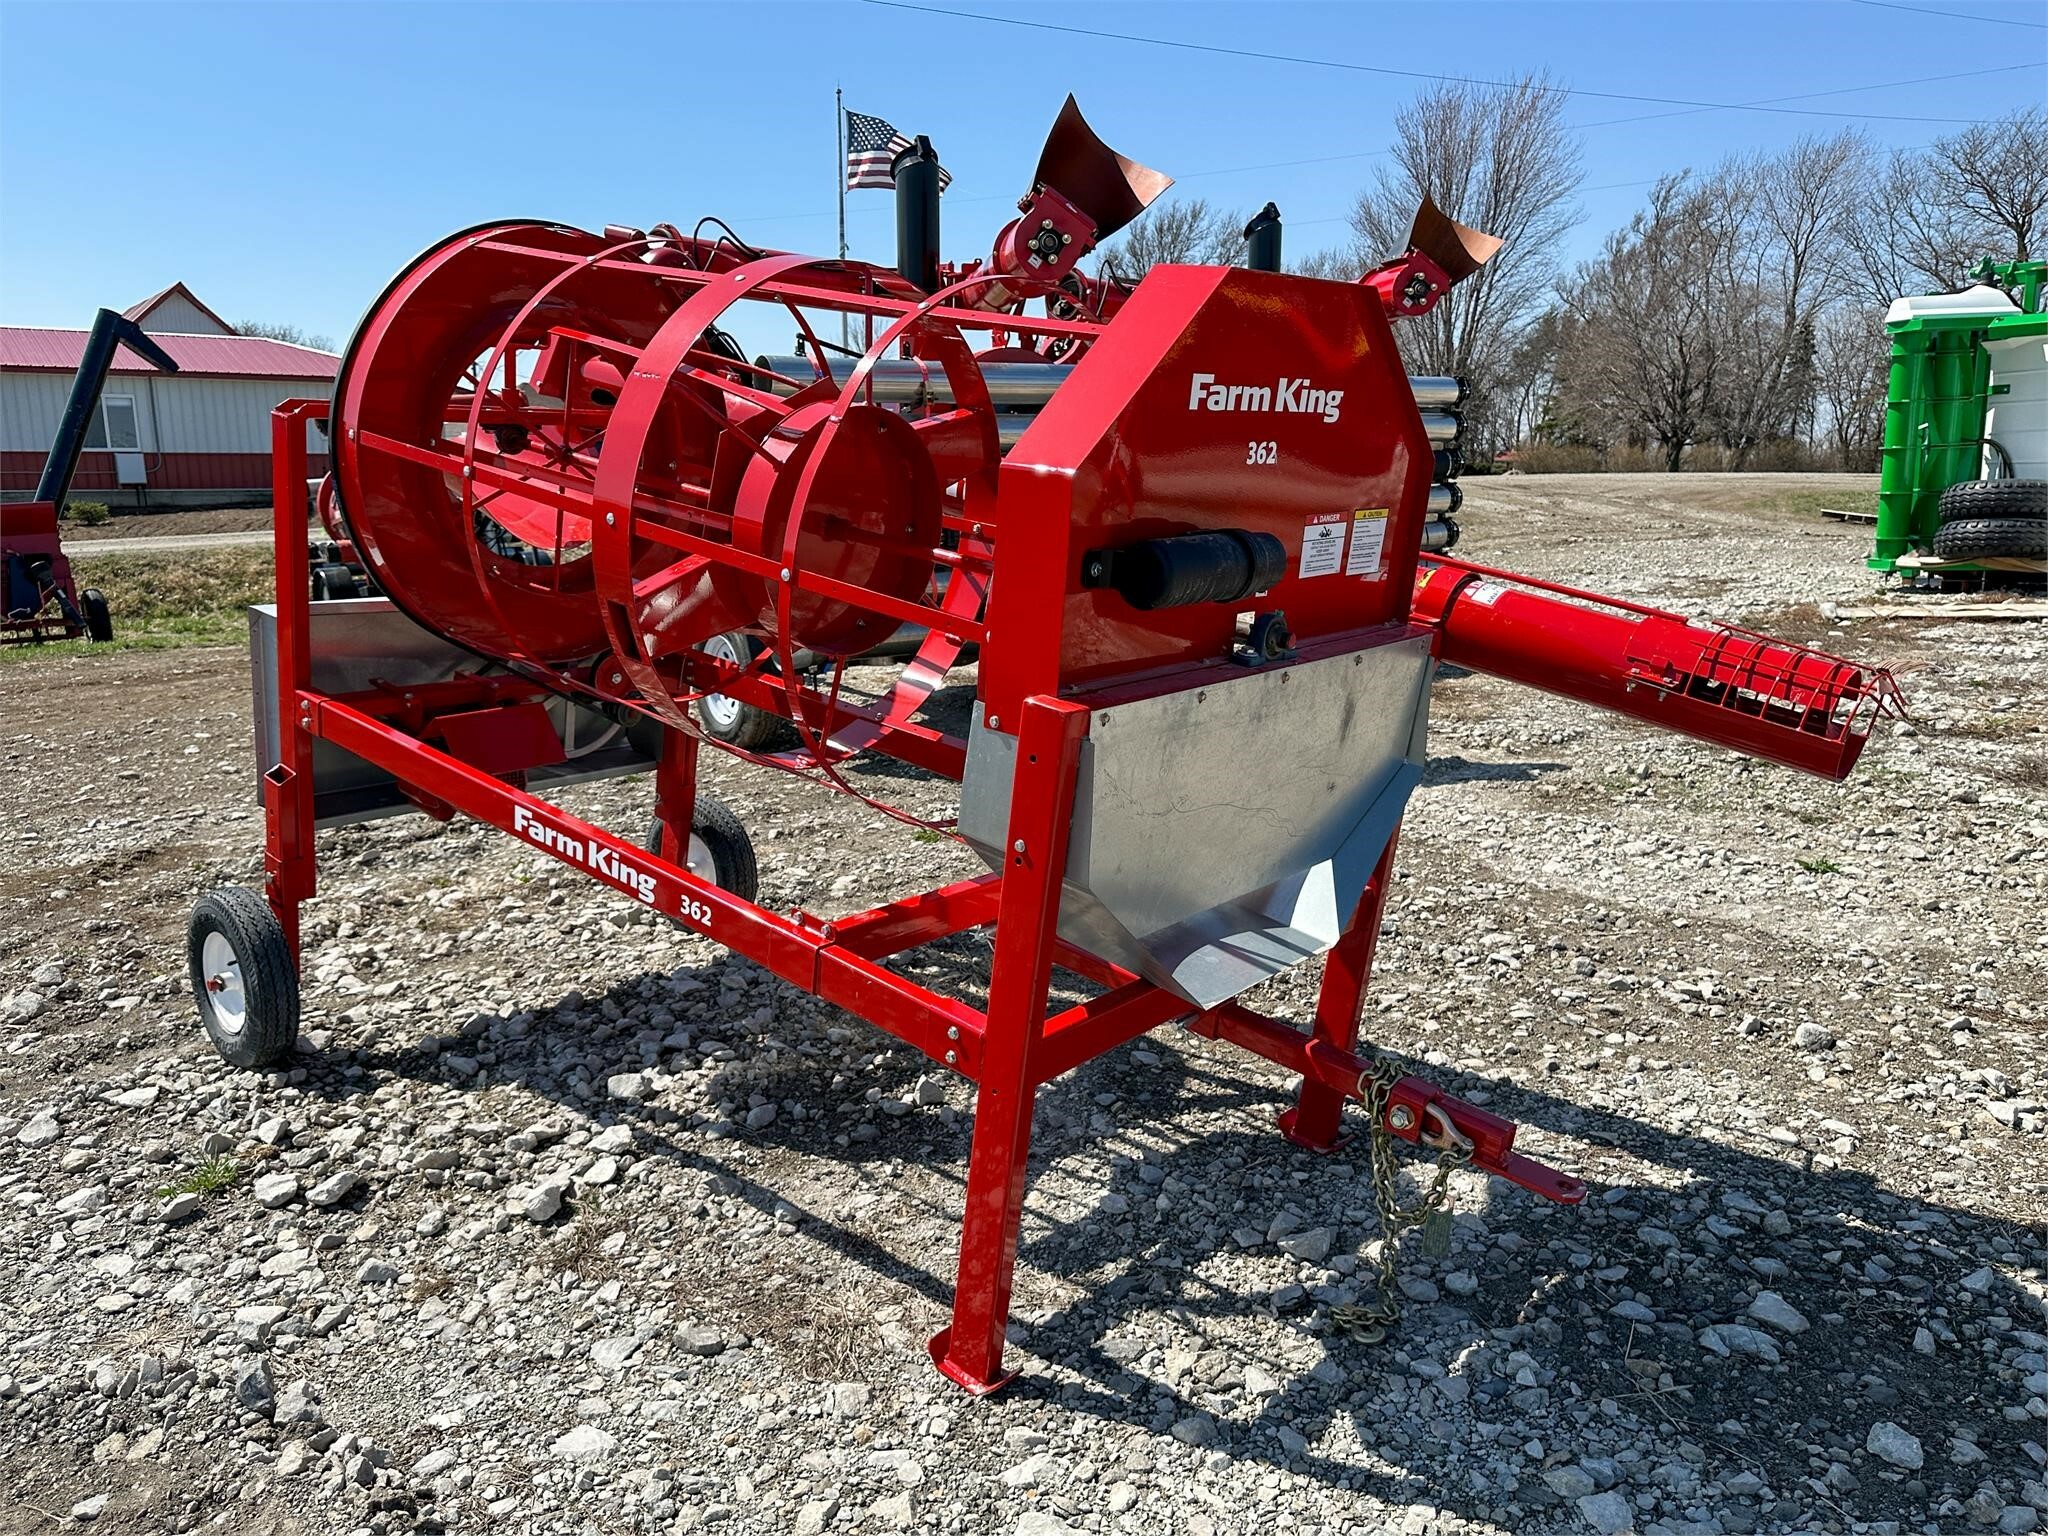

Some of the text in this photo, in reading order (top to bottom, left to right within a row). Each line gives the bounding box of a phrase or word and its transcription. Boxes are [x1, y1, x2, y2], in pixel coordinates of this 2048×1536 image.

[1189, 373, 1344, 423] Farm King
[1246, 441, 1277, 465] 362
[1319, 513, 1341, 523] DANGER
[514, 805, 657, 904] Farm King
[680, 895, 712, 927] 362
